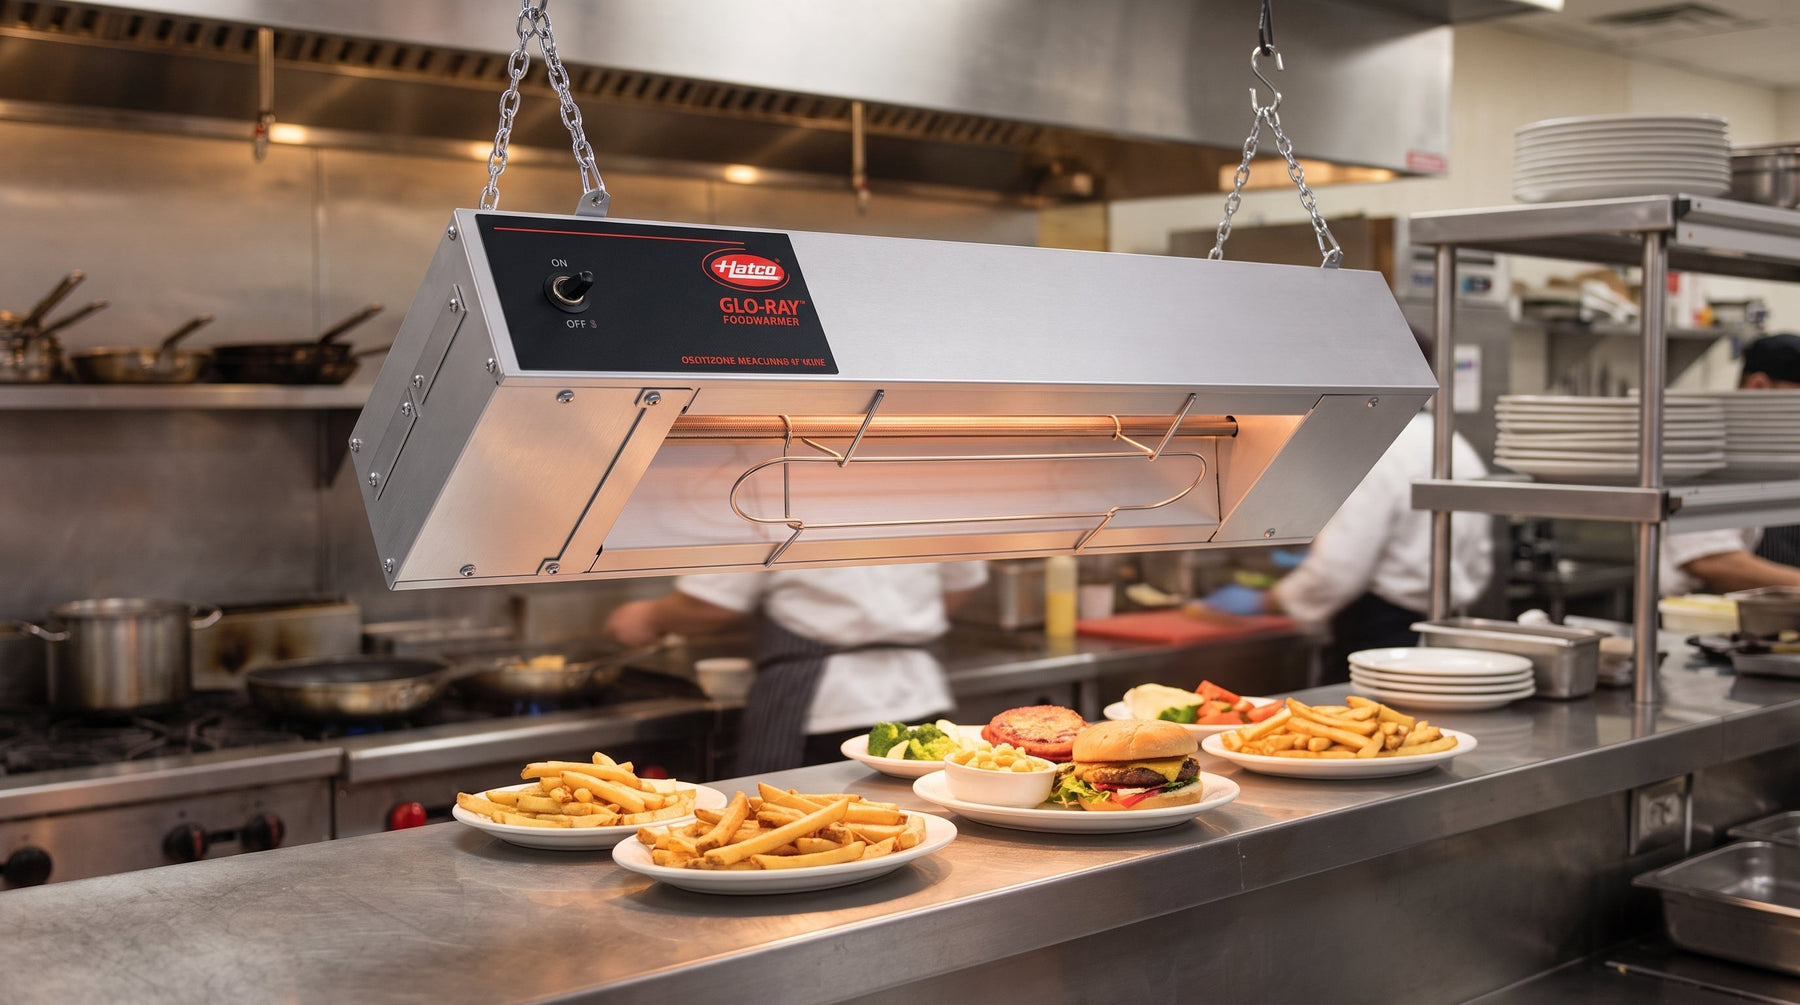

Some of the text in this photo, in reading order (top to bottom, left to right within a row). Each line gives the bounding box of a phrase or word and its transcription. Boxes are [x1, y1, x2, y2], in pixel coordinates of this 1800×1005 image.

[551, 258, 568, 268] ON
[714, 259, 782, 281] Hatco
[566, 319, 586, 329] OFF
[723, 315, 800, 327] FOODWARMER
